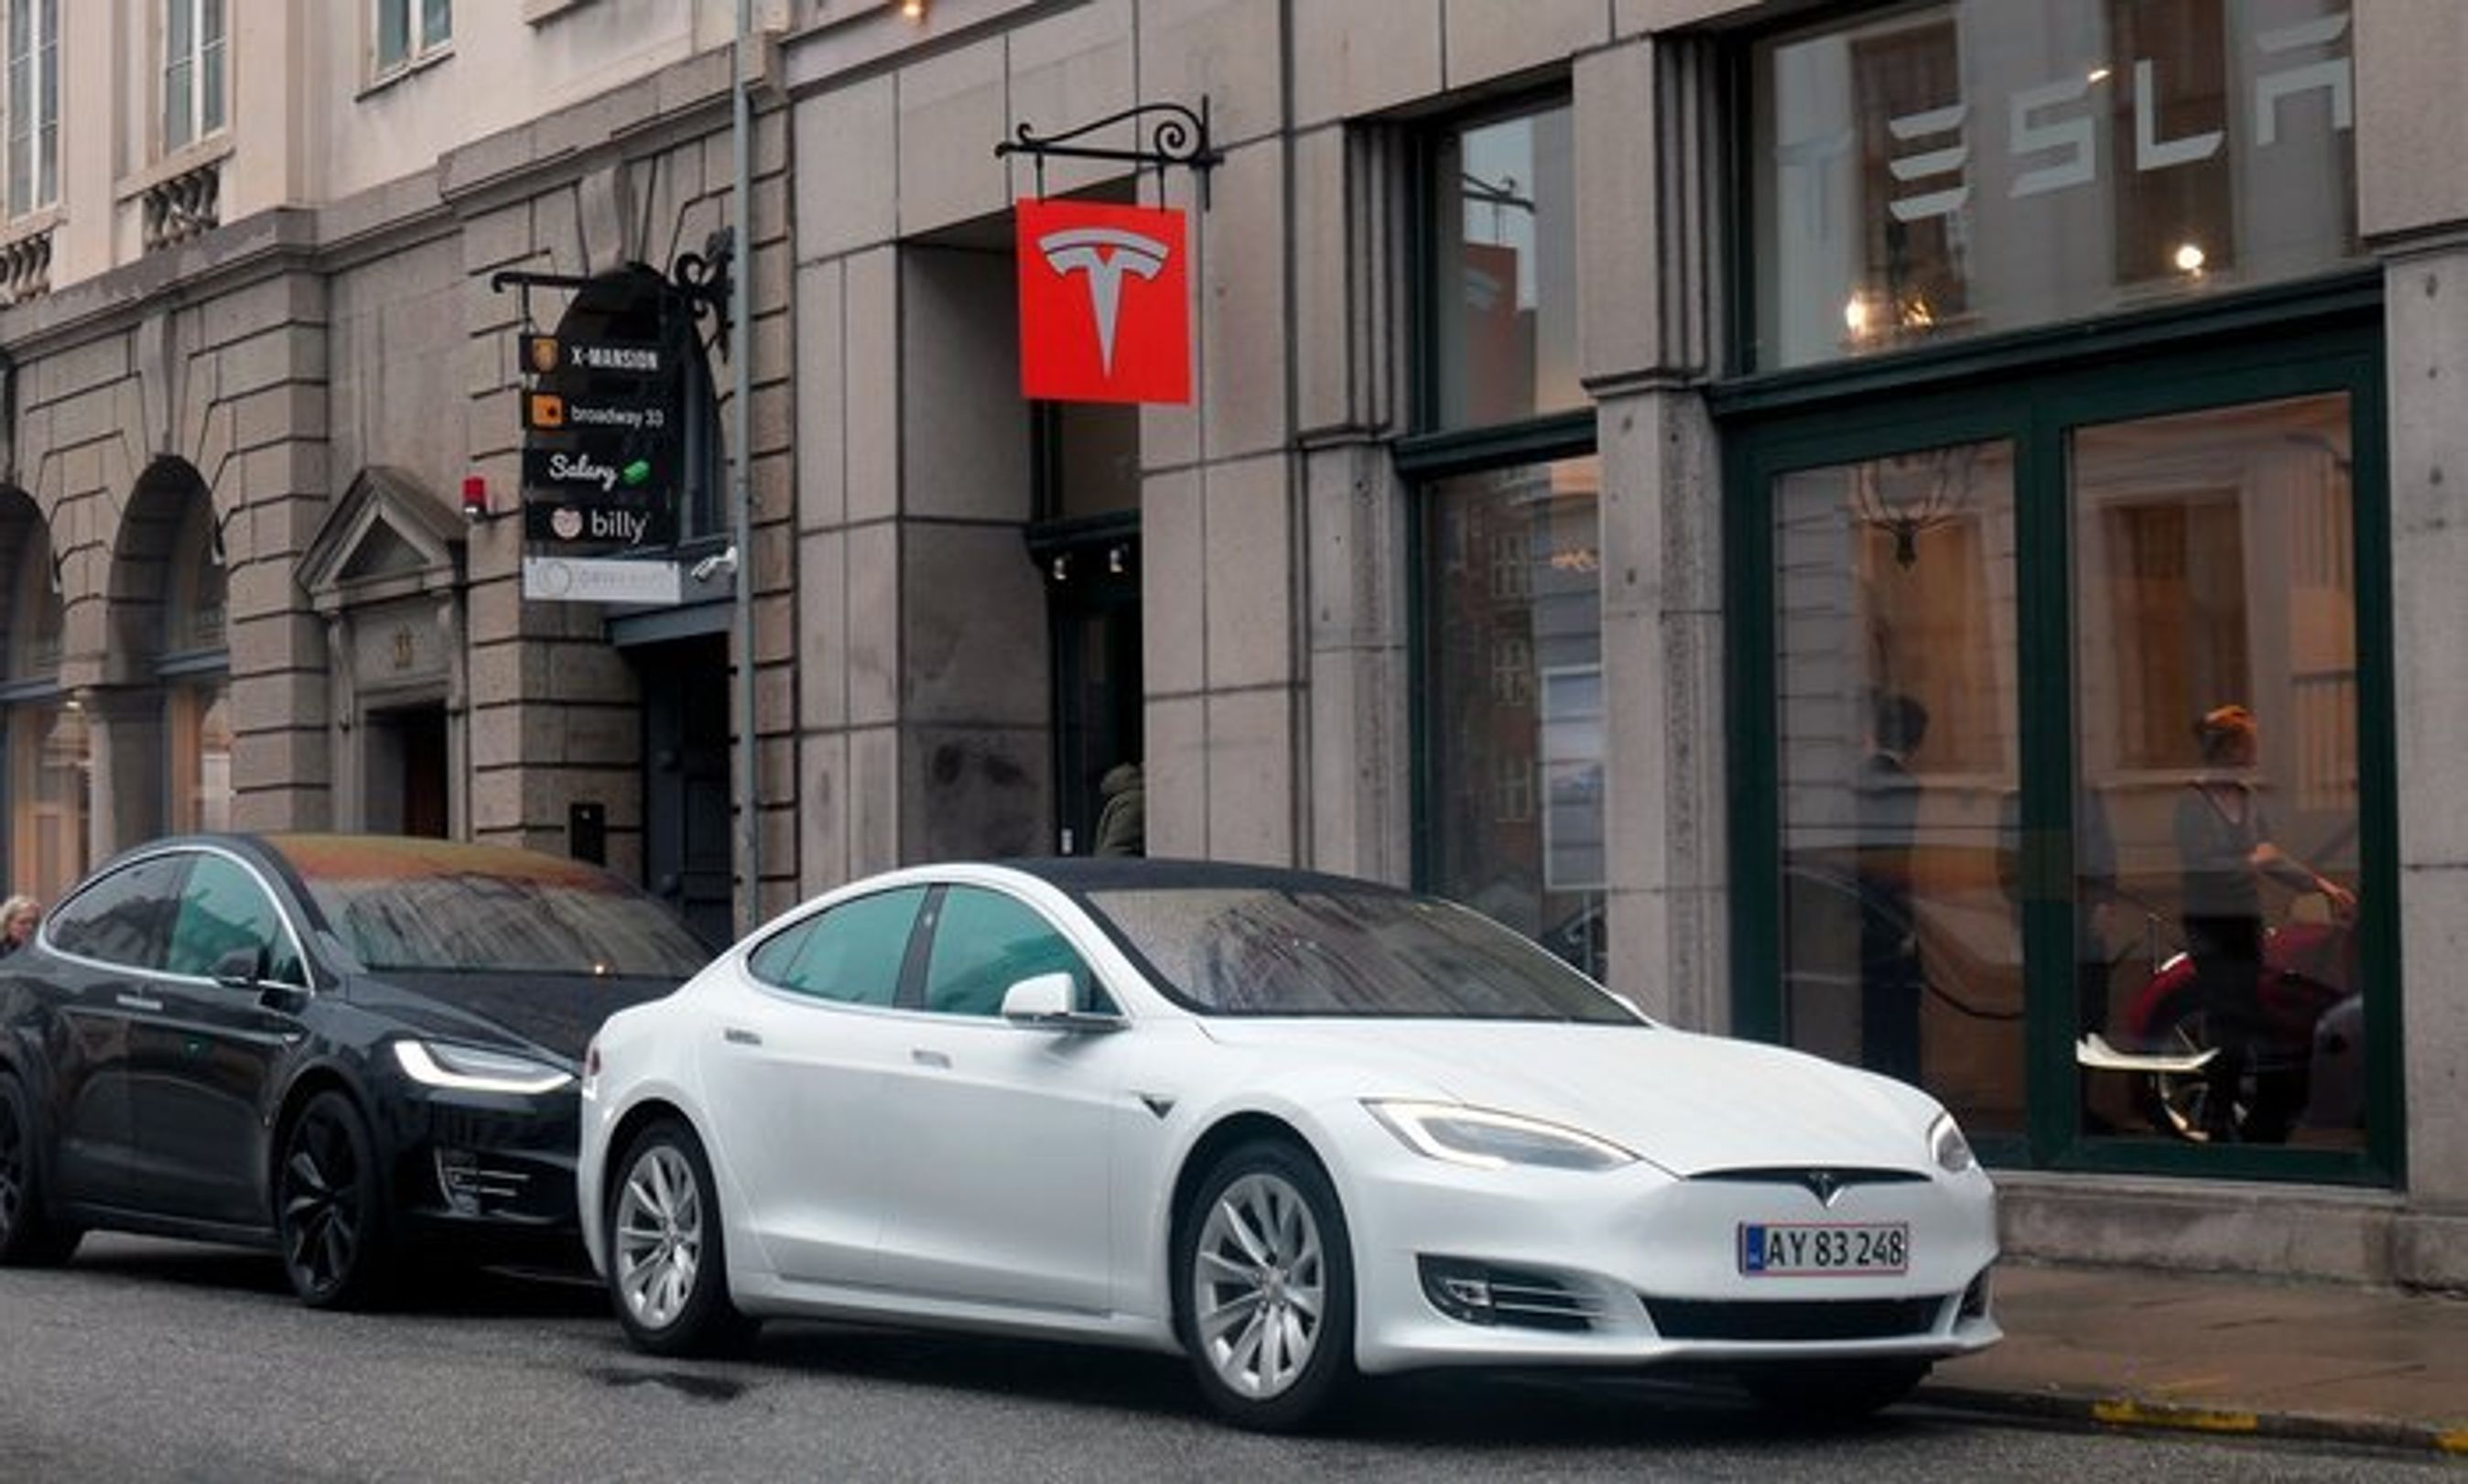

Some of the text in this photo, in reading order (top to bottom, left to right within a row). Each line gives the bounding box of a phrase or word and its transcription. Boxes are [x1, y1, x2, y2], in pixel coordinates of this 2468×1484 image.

[569, 345, 659, 371] X-MANSION
[570, 404, 643, 429] broadway
[590, 508, 646, 545] billy
[1768, 1230, 1903, 1267] AY 83 248
